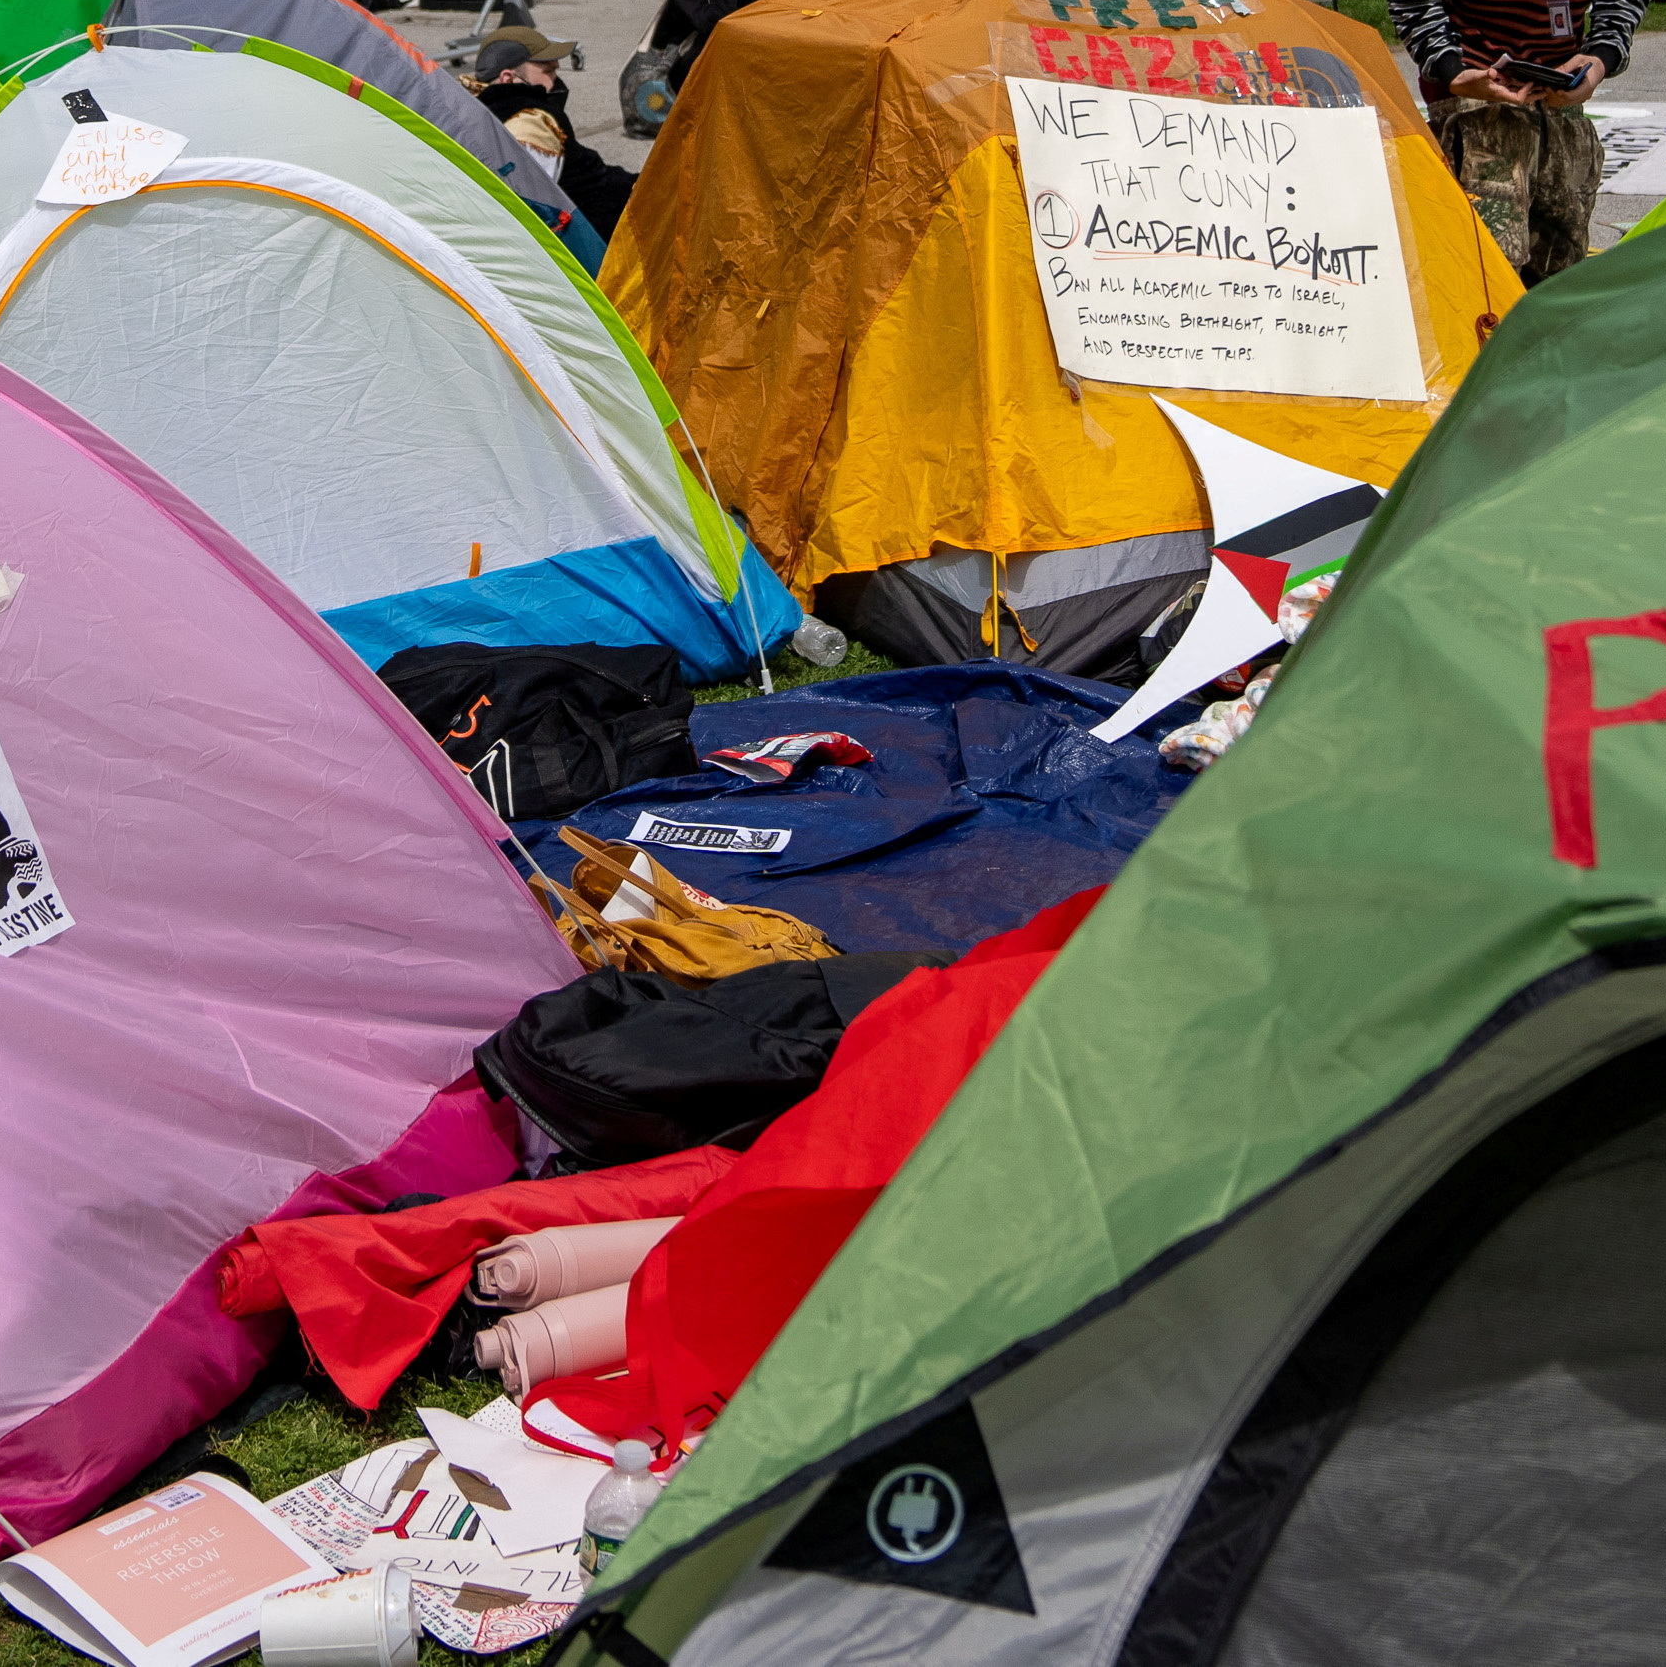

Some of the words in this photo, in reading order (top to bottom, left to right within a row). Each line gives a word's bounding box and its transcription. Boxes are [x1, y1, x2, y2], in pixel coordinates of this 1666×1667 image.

[1030, 24, 1301, 107] GAZA!
[77, 125, 108, 148] IN
[1020, 84, 1109, 138] WE
[1129, 98, 1296, 166] DEMAND
[67, 145, 126, 167] until
[1081, 159, 1159, 200] THAT
[1084, 204, 1256, 262] ACADEMIC
[1048, 257, 1091, 298] BAN
[1099, 277, 1126, 294] ALL
[1132, 277, 1213, 300] ACADEMIC
[1218, 280, 1261, 300] TRIPS
[1263, 282, 1284, 302] TO
[1291, 283, 1347, 311] ISRAEL,
[1077, 306, 1171, 330] ENCOMPASSING
[1179, 311, 1264, 335] BIRTHRIGHT,
[1274, 317, 1349, 344] FULBRIGHT,
[1082, 337, 1113, 357] AND
[1120, 339, 1204, 362] PERSPECTIVE
[1211, 344, 1256, 364] TRIPS.
[280, 1502, 302, 1517] FREE
[307, 1485, 327, 1502] FREE
[112, 1515, 180, 1551] essentials
[134, 1538, 162, 1556] SUPER
[162, 1530, 183, 1545] SOFT
[116, 1525, 226, 1582] REVERSIBLE
[149, 1547, 221, 1586] THROW
[393, 1556, 480, 1575] INTO
[190, 1576, 235, 1600] OVERSIZED
[179, 1631, 210, 1652] quality
[211, 1610, 252, 1633] materials
